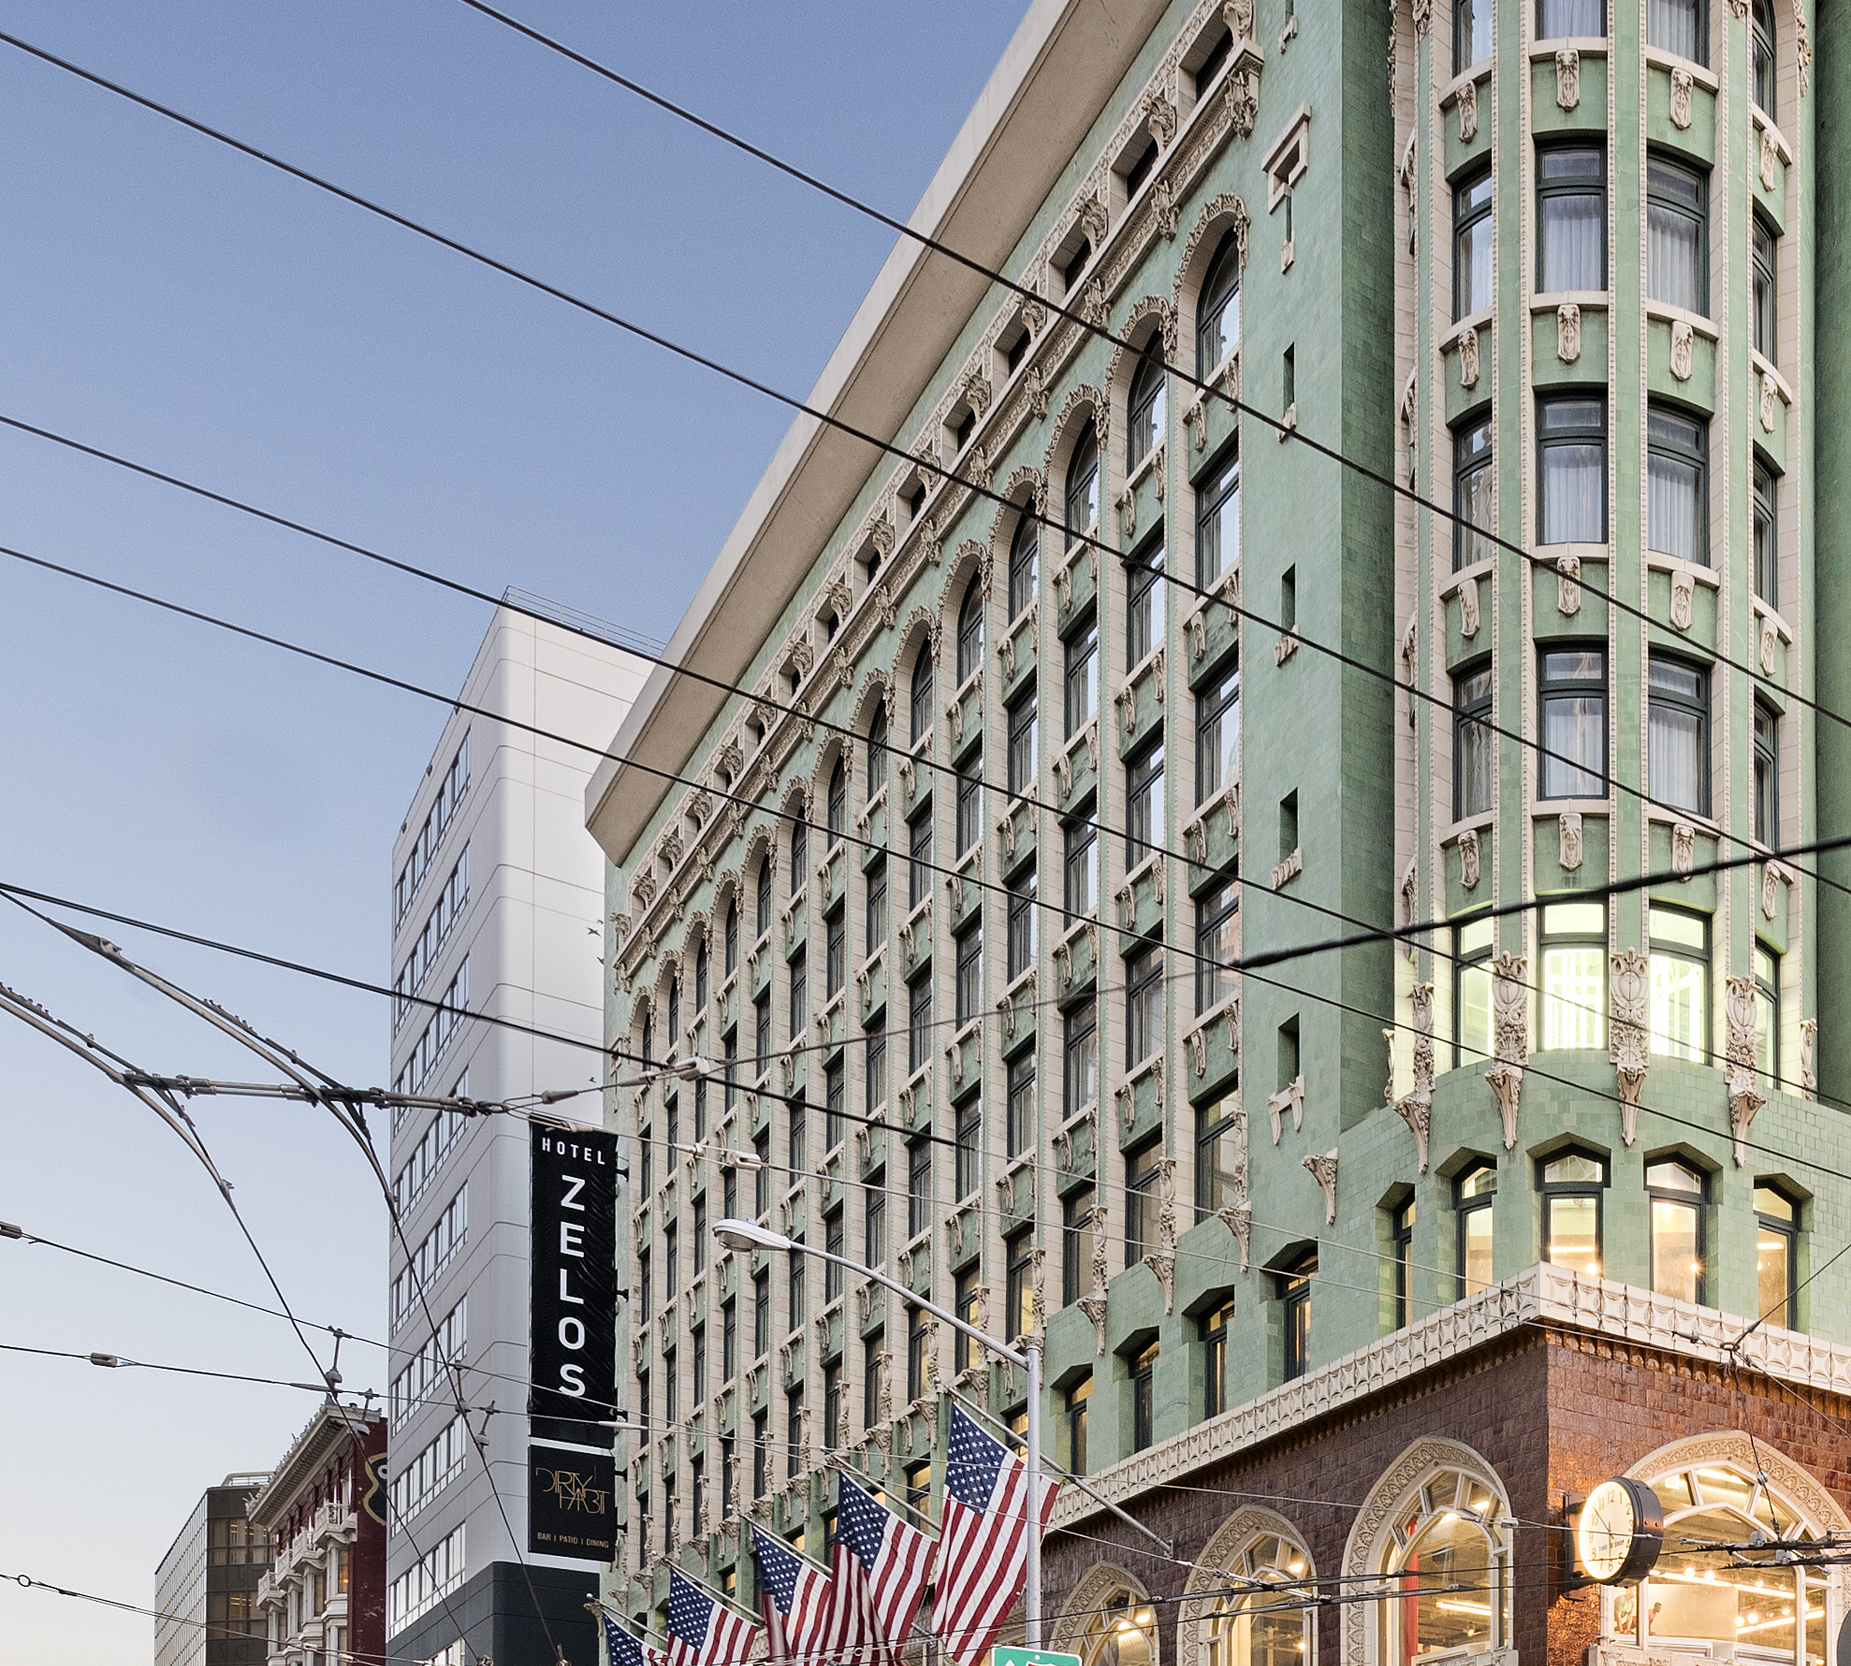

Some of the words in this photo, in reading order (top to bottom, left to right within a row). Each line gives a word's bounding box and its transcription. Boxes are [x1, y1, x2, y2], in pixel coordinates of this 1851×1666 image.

[542, 1137, 605, 1165] HOTEL
[558, 1174, 586, 1398] ZELOS
[537, 1532, 551, 1541] BAR
[559, 1534, 578, 1544] PATIO
[586, 1538, 609, 1549] DINING
